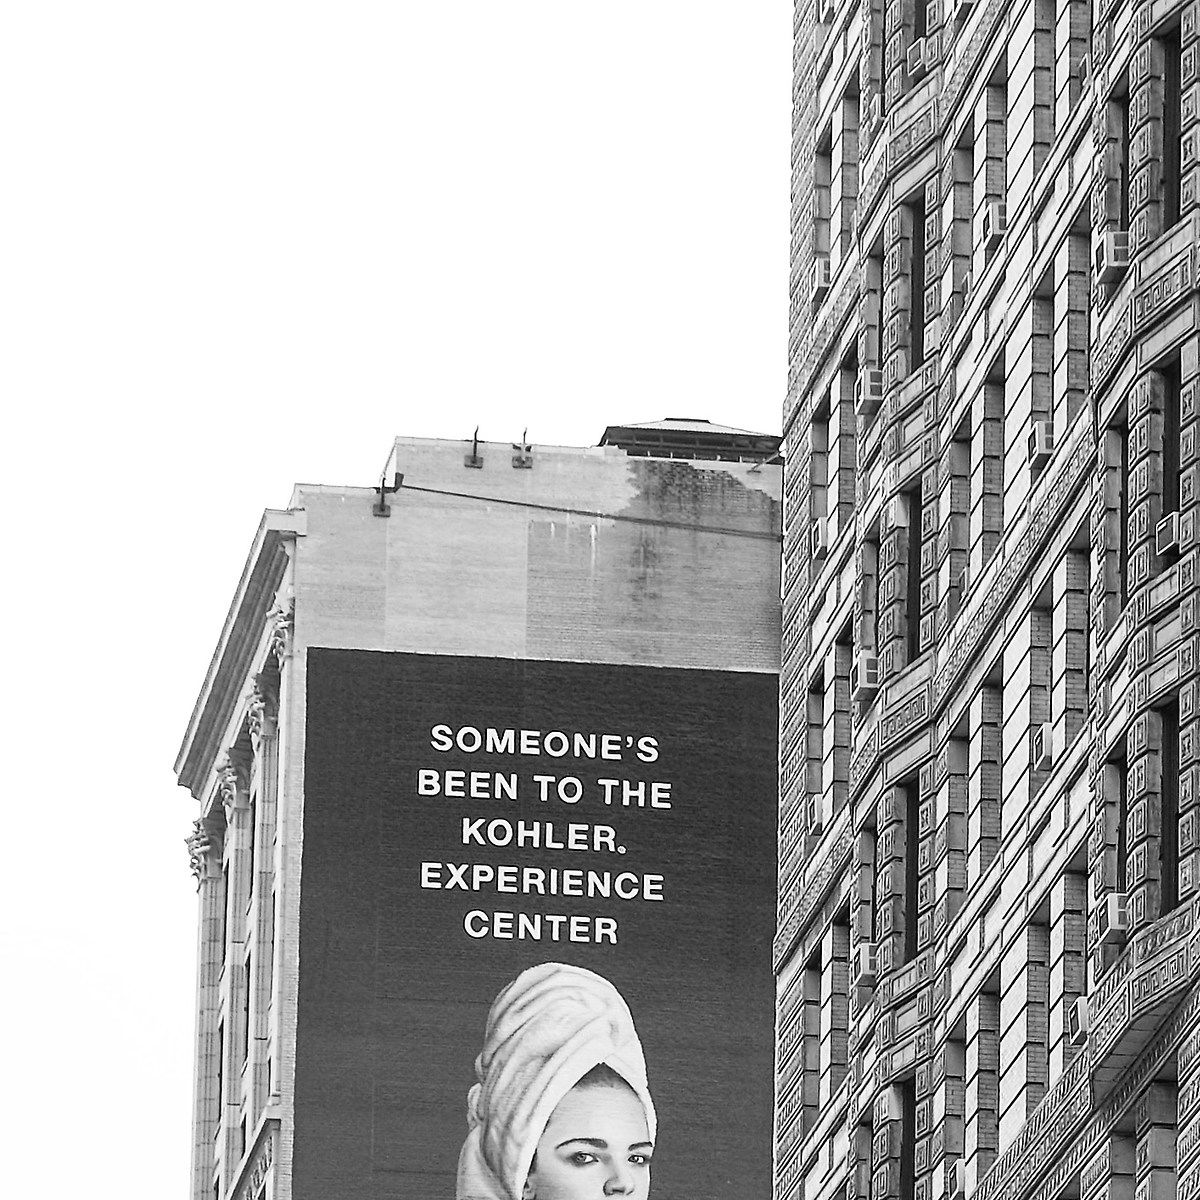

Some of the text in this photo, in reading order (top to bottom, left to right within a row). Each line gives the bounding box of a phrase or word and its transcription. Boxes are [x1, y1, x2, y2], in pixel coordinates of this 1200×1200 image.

[431, 724, 659, 762] SOMEONE'S
[418, 769, 672, 809] BEEN TO THE
[420, 862, 664, 900] EXPERIENCE
[464, 910, 618, 944] CENTER
